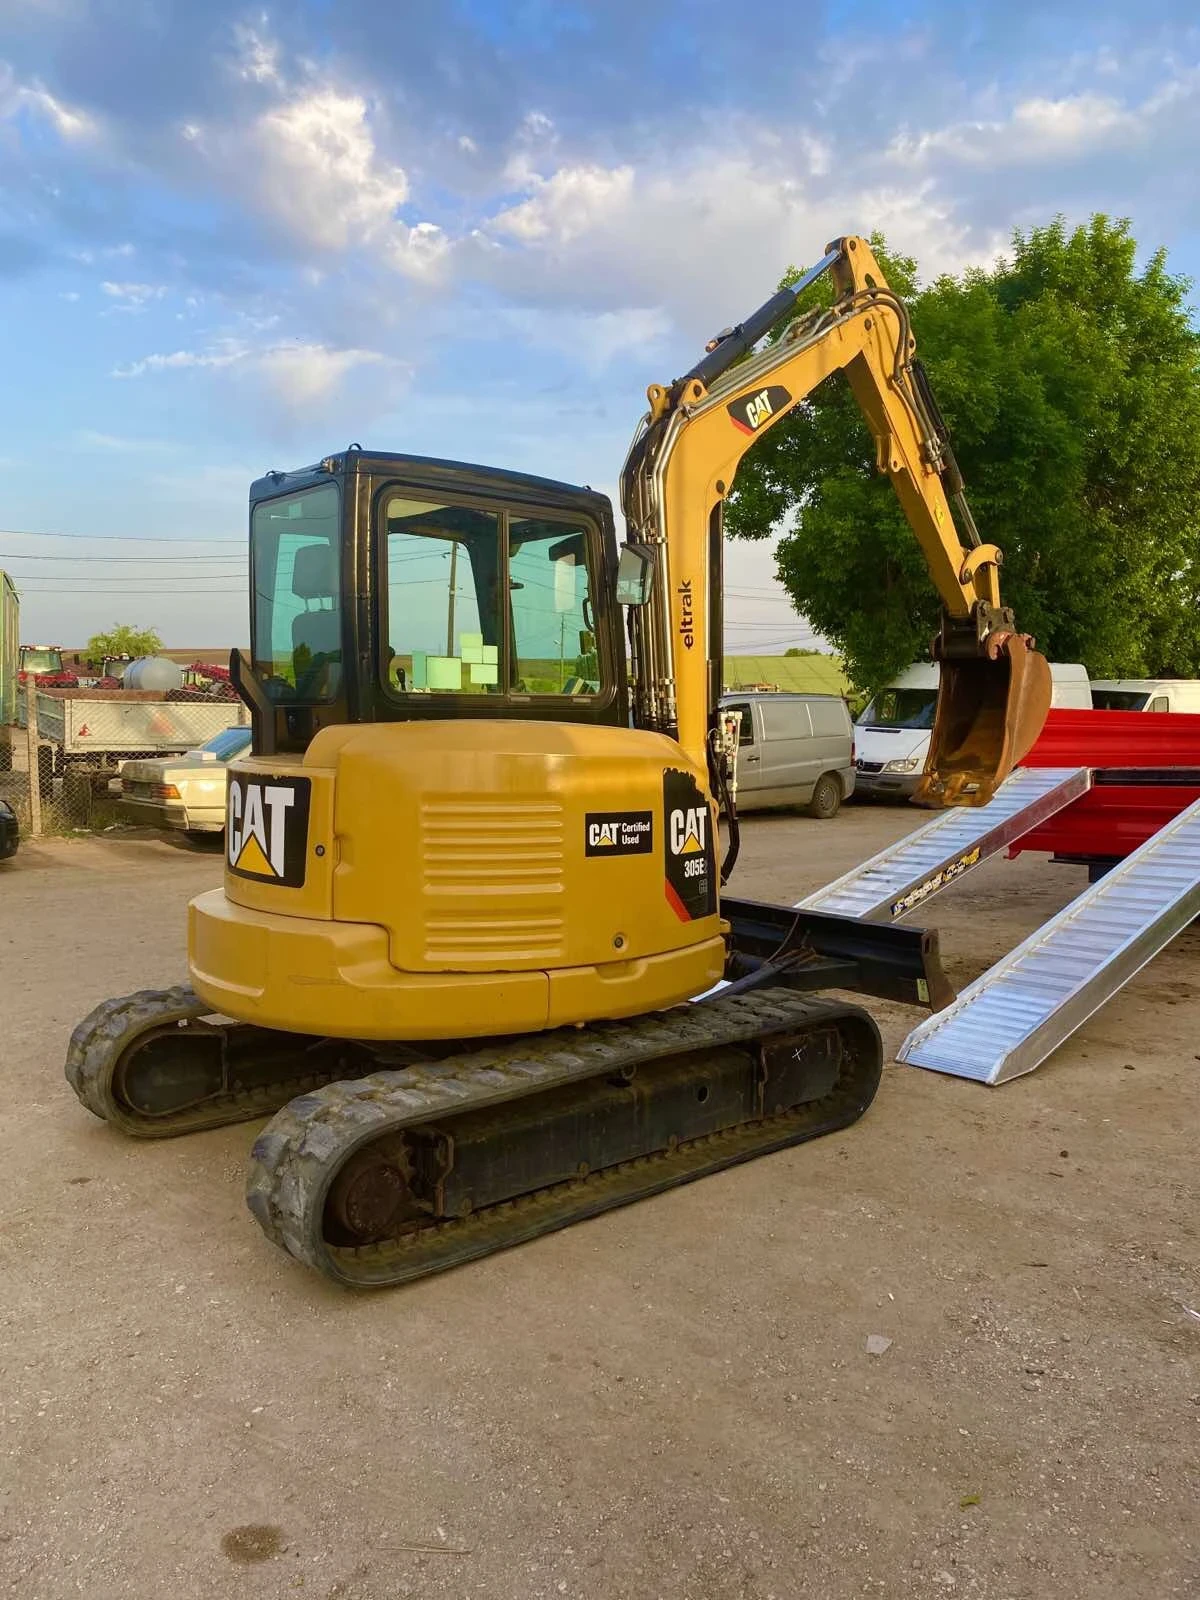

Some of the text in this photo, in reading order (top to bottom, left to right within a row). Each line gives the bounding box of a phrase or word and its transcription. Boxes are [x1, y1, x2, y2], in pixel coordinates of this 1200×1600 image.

[746, 389, 773, 428] CAT
[678, 579, 694, 650] eltrak
[229, 780, 295, 878] CAT
[589, 822, 619, 847] CAT
[621, 821, 650, 833] Certified
[621, 833, 640, 845] Used
[671, 807, 707, 855] CAT
